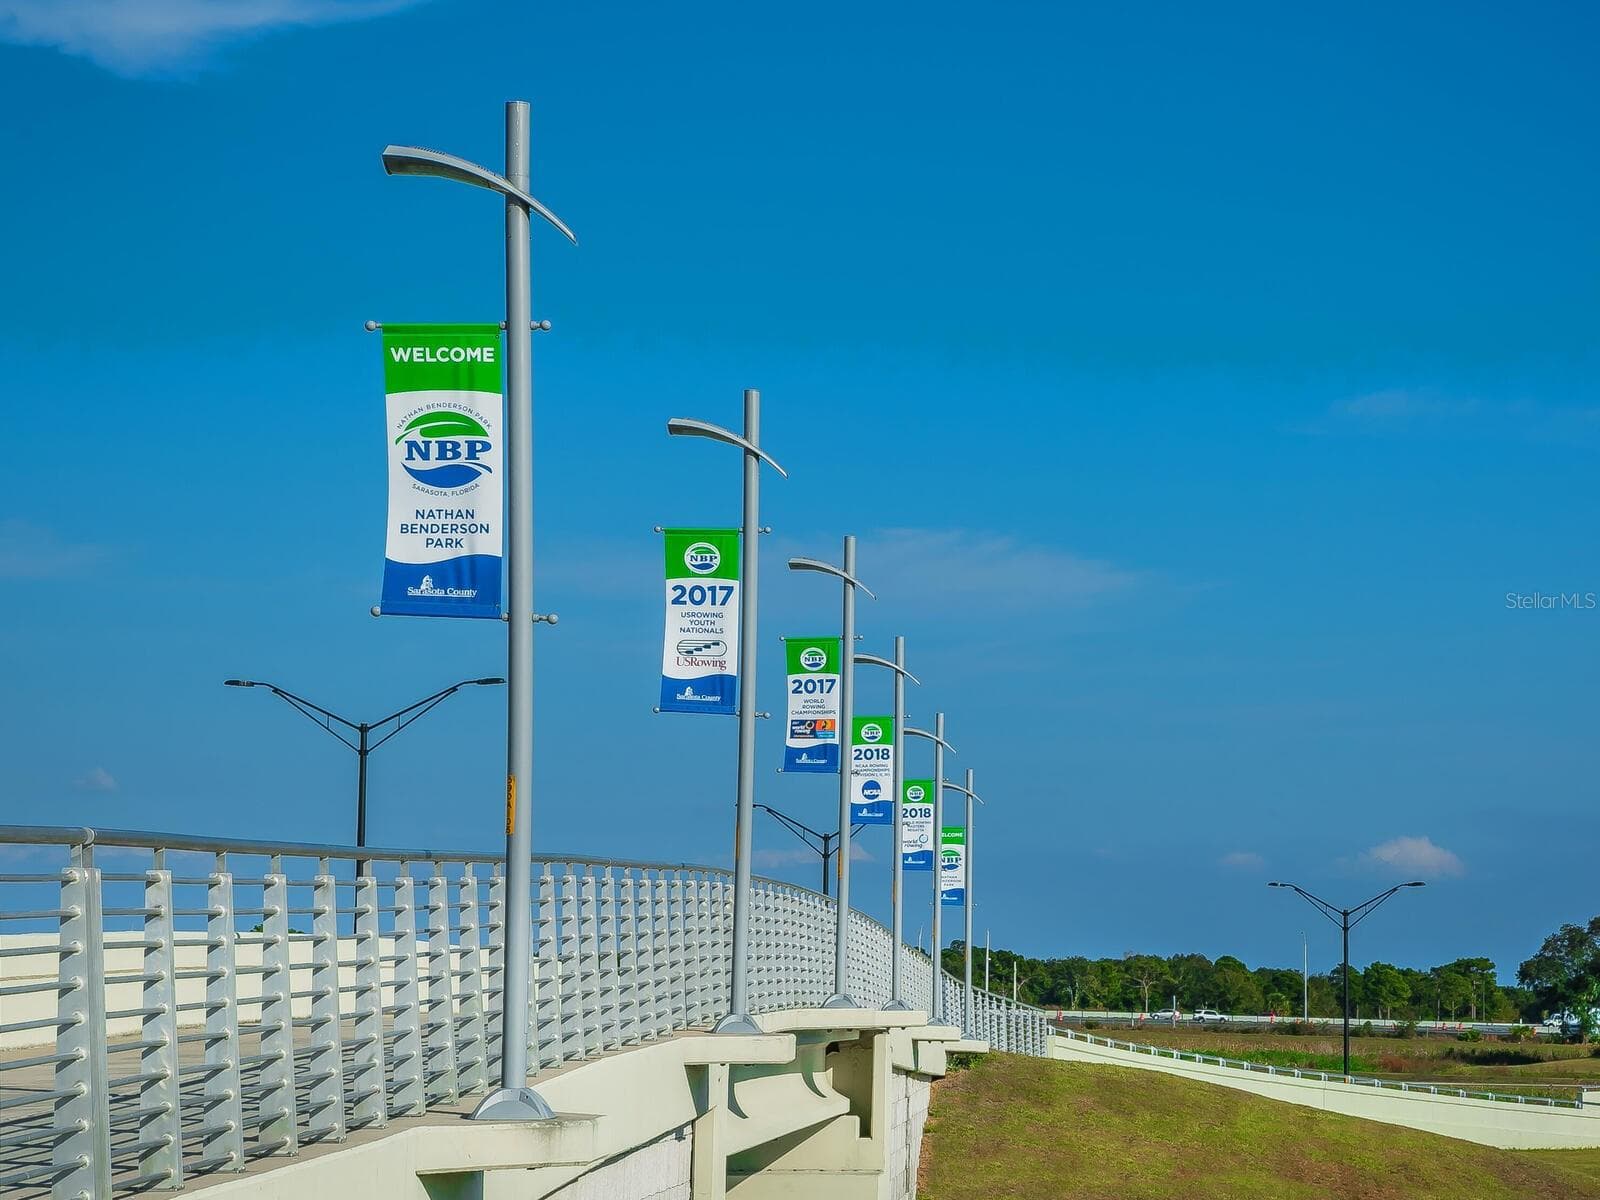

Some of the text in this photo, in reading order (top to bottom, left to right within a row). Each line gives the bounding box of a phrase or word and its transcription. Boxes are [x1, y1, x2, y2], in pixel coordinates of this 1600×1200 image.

[390, 347, 495, 362] WELCOME
[396, 402, 493, 430] NATHAN BENDERSON PARK
[404, 440, 492, 461] NBP
[411, 483, 480, 498] SARASOTA, FLORIDA
[415, 509, 475, 520] NATHAN
[400, 523, 490, 534] BENDERSON
[425, 537, 464, 548] PARK
[689, 554, 718, 563] NBP
[407, 587, 478, 598] Sarasota County
[671, 584, 734, 606] 2017
[681, 611, 724, 619] USROWING
[676, 656, 727, 671] USRowing
[803, 655, 825, 663] NBP
[791, 679, 836, 694] 2017
[853, 748, 890, 760] 2018
[902, 807, 931, 818] 2018
